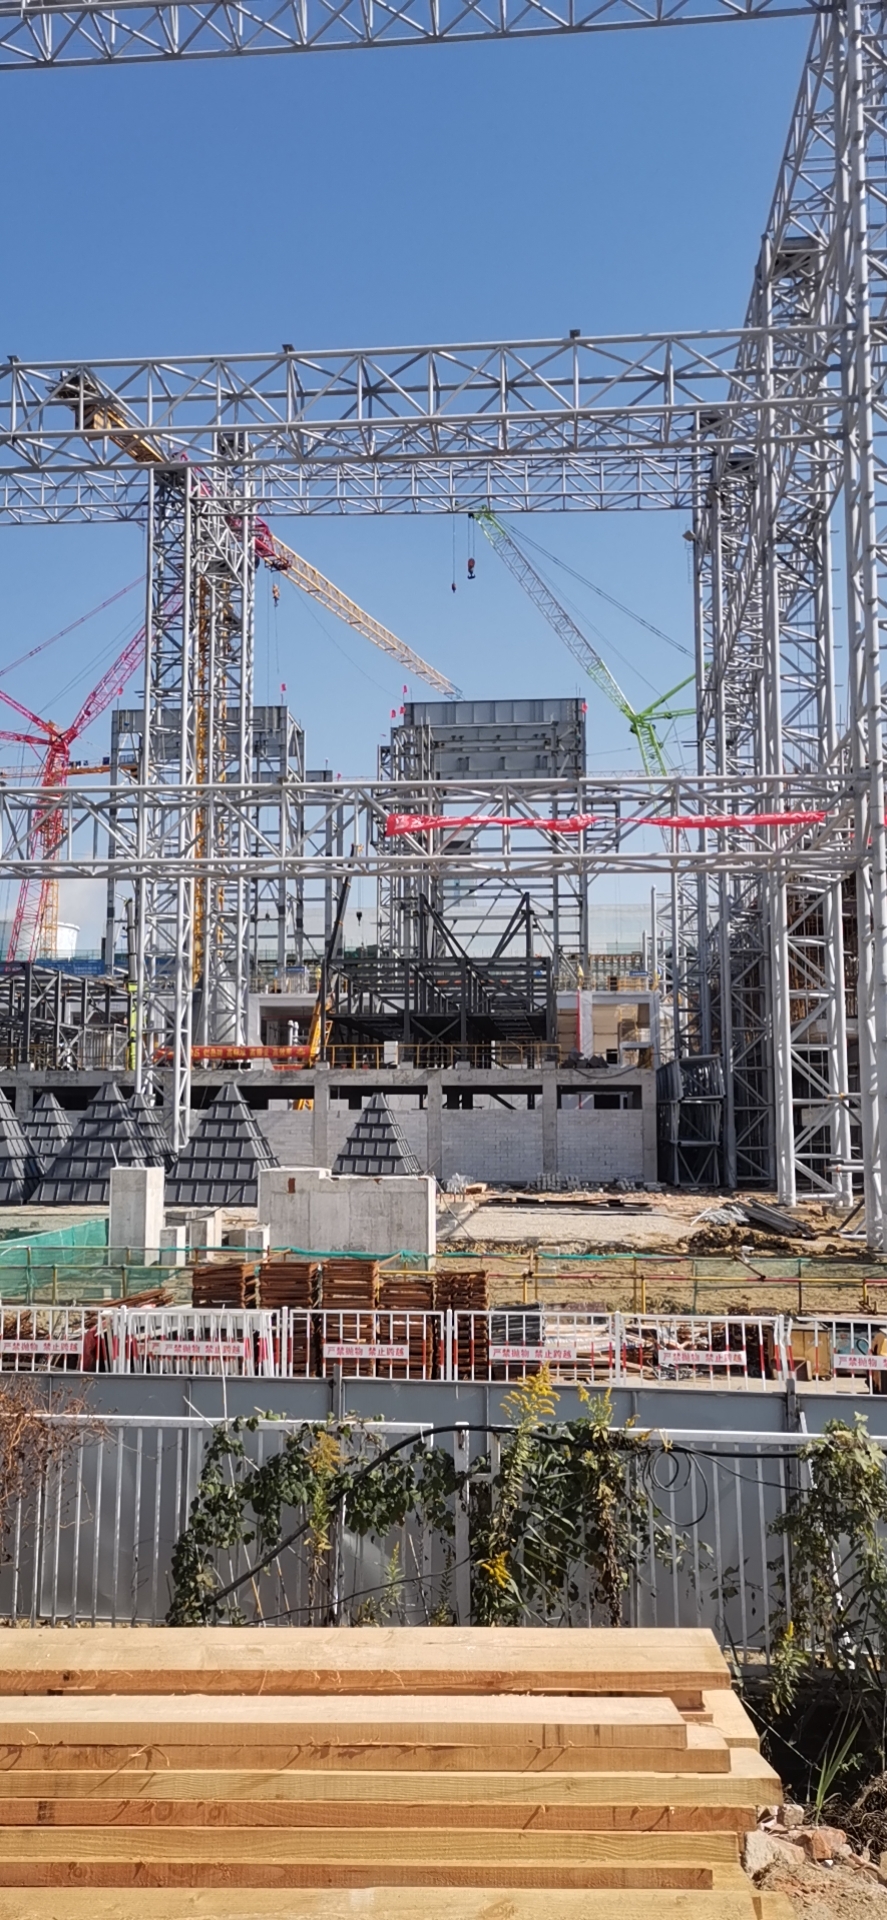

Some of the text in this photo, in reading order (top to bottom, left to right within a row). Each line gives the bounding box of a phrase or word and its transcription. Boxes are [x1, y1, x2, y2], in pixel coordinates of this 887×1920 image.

[4, 1342, 78, 1352] 严禁抛物 禁止跨越
[165, 1344, 240, 1354] 严禁抛物 禁止跨越
[327, 1346, 404, 1357] 严禁抛物 禁止跨越
[492, 1348, 572, 1359] 严禁抛物 禁止跨越
[663, 1352, 742, 1363] 严禁抛物 禁止跨越
[838, 1356, 878, 1367] 严禁抛物
